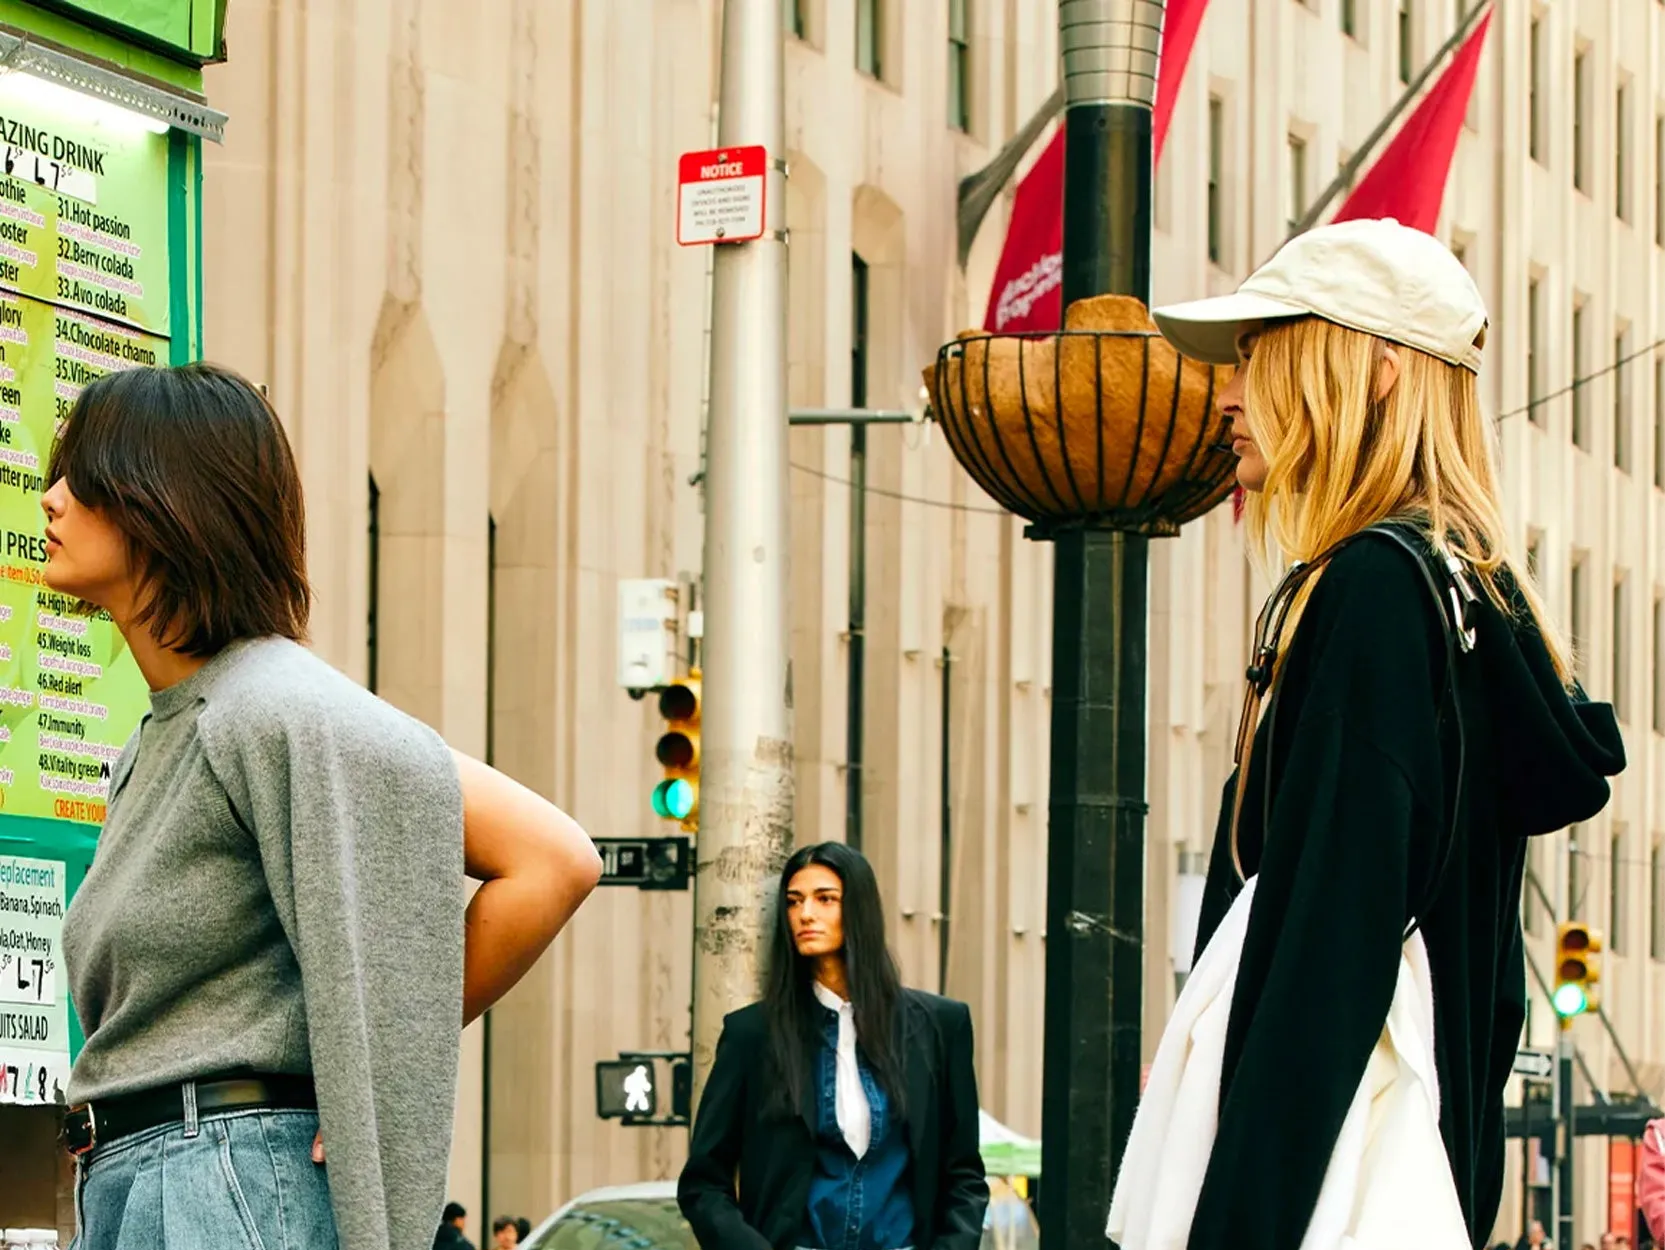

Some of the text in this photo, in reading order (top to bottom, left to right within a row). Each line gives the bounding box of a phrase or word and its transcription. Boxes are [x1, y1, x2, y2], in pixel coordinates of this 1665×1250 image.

[53, 135, 104, 176] DRINK
[700, 162, 743, 178] NOTICE
[57, 196, 91, 227] 31.Hot
[92, 215, 130, 240] passion
[57, 236, 99, 271] 32.Berry
[101, 253, 134, 280] colada
[57, 276, 93, 306] 33.Avo
[94, 289, 127, 316] colada
[0, 300, 23, 329] lory
[55, 318, 121, 357] 34.Chocolate
[122, 339, 156, 366] champ
[0, 386, 21, 406] een
[7, 530, 51, 564] PRES
[37, 632, 76, 657] 45.Weight
[76, 638, 92, 658] loss
[37, 672, 83, 696] 46.Red alert
[37, 713, 86, 740] 47.Immunity
[38, 754, 77, 779] 48.Vitality
[77, 761, 100, 780] green
[54, 798, 86, 820] CREATE
[0, 859, 55, 890] eplacement
[18, 1013, 48, 1041] SALAD
[38, 1065, 48, 1103] 8
